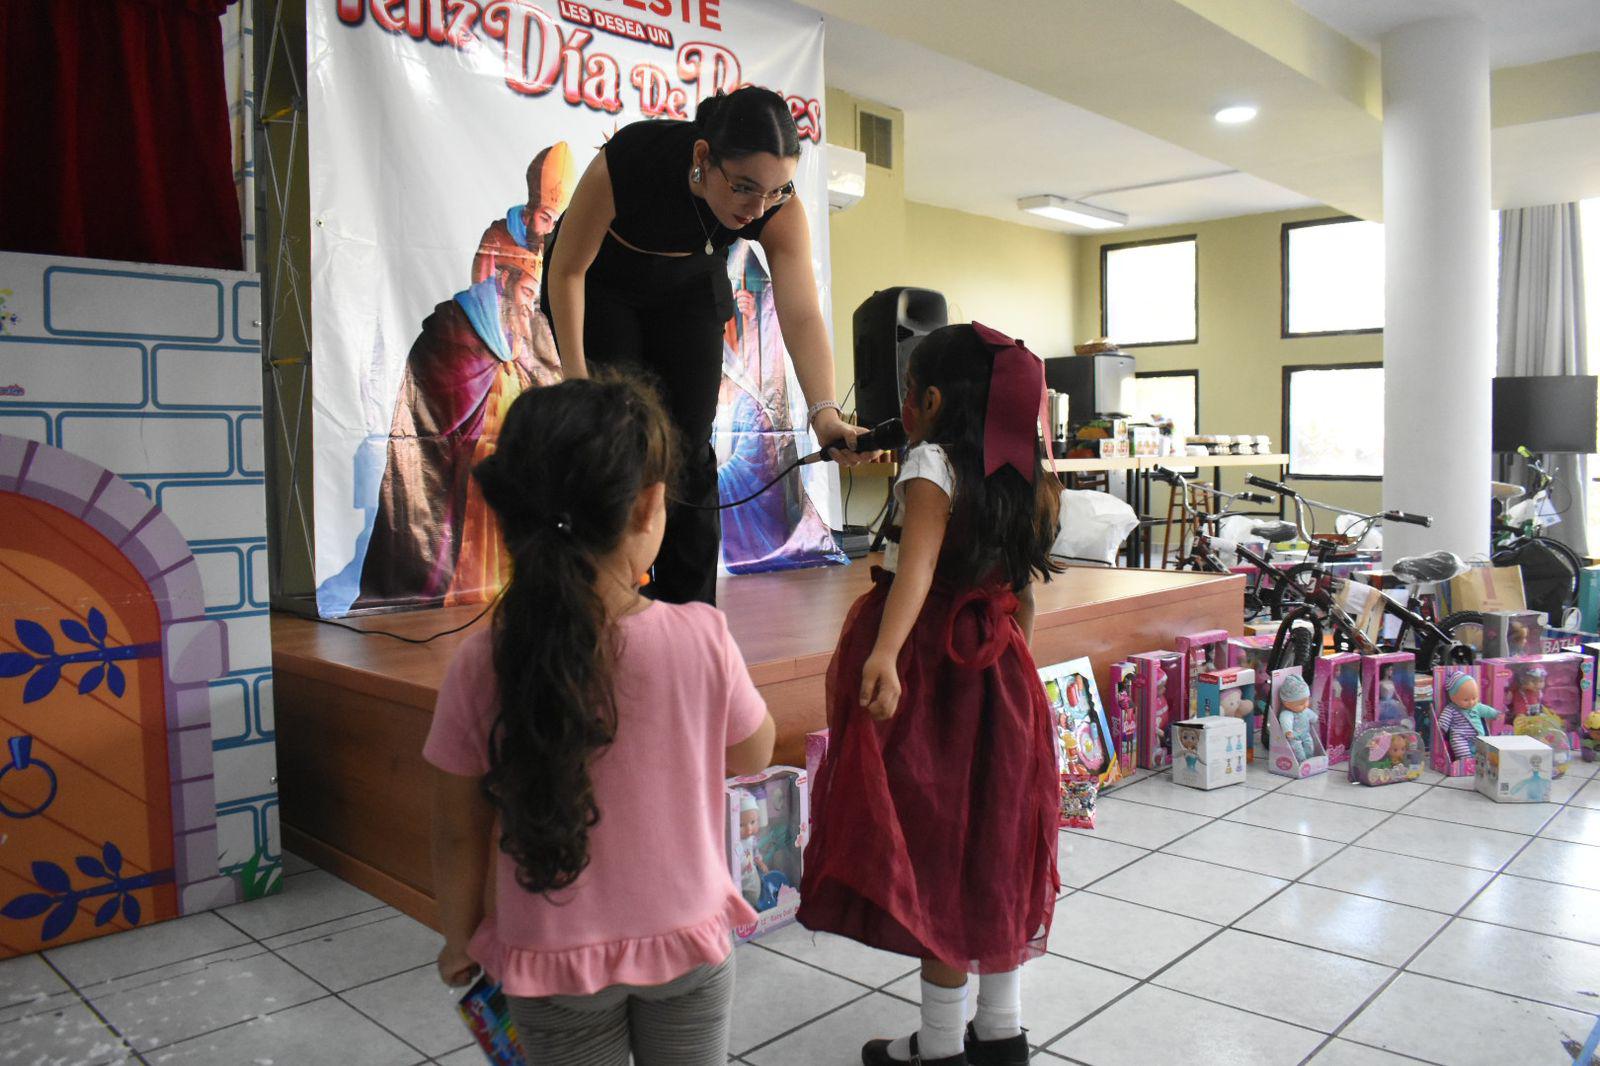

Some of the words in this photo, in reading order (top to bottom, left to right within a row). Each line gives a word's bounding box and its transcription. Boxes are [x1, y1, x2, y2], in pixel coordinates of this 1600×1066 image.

[482, 1, 623, 113] Día
[631, 64, 688, 119] De
[559, 2, 591, 24] LES
[594, 11, 645, 38] DESEA
[647, 26, 671, 45] UN
